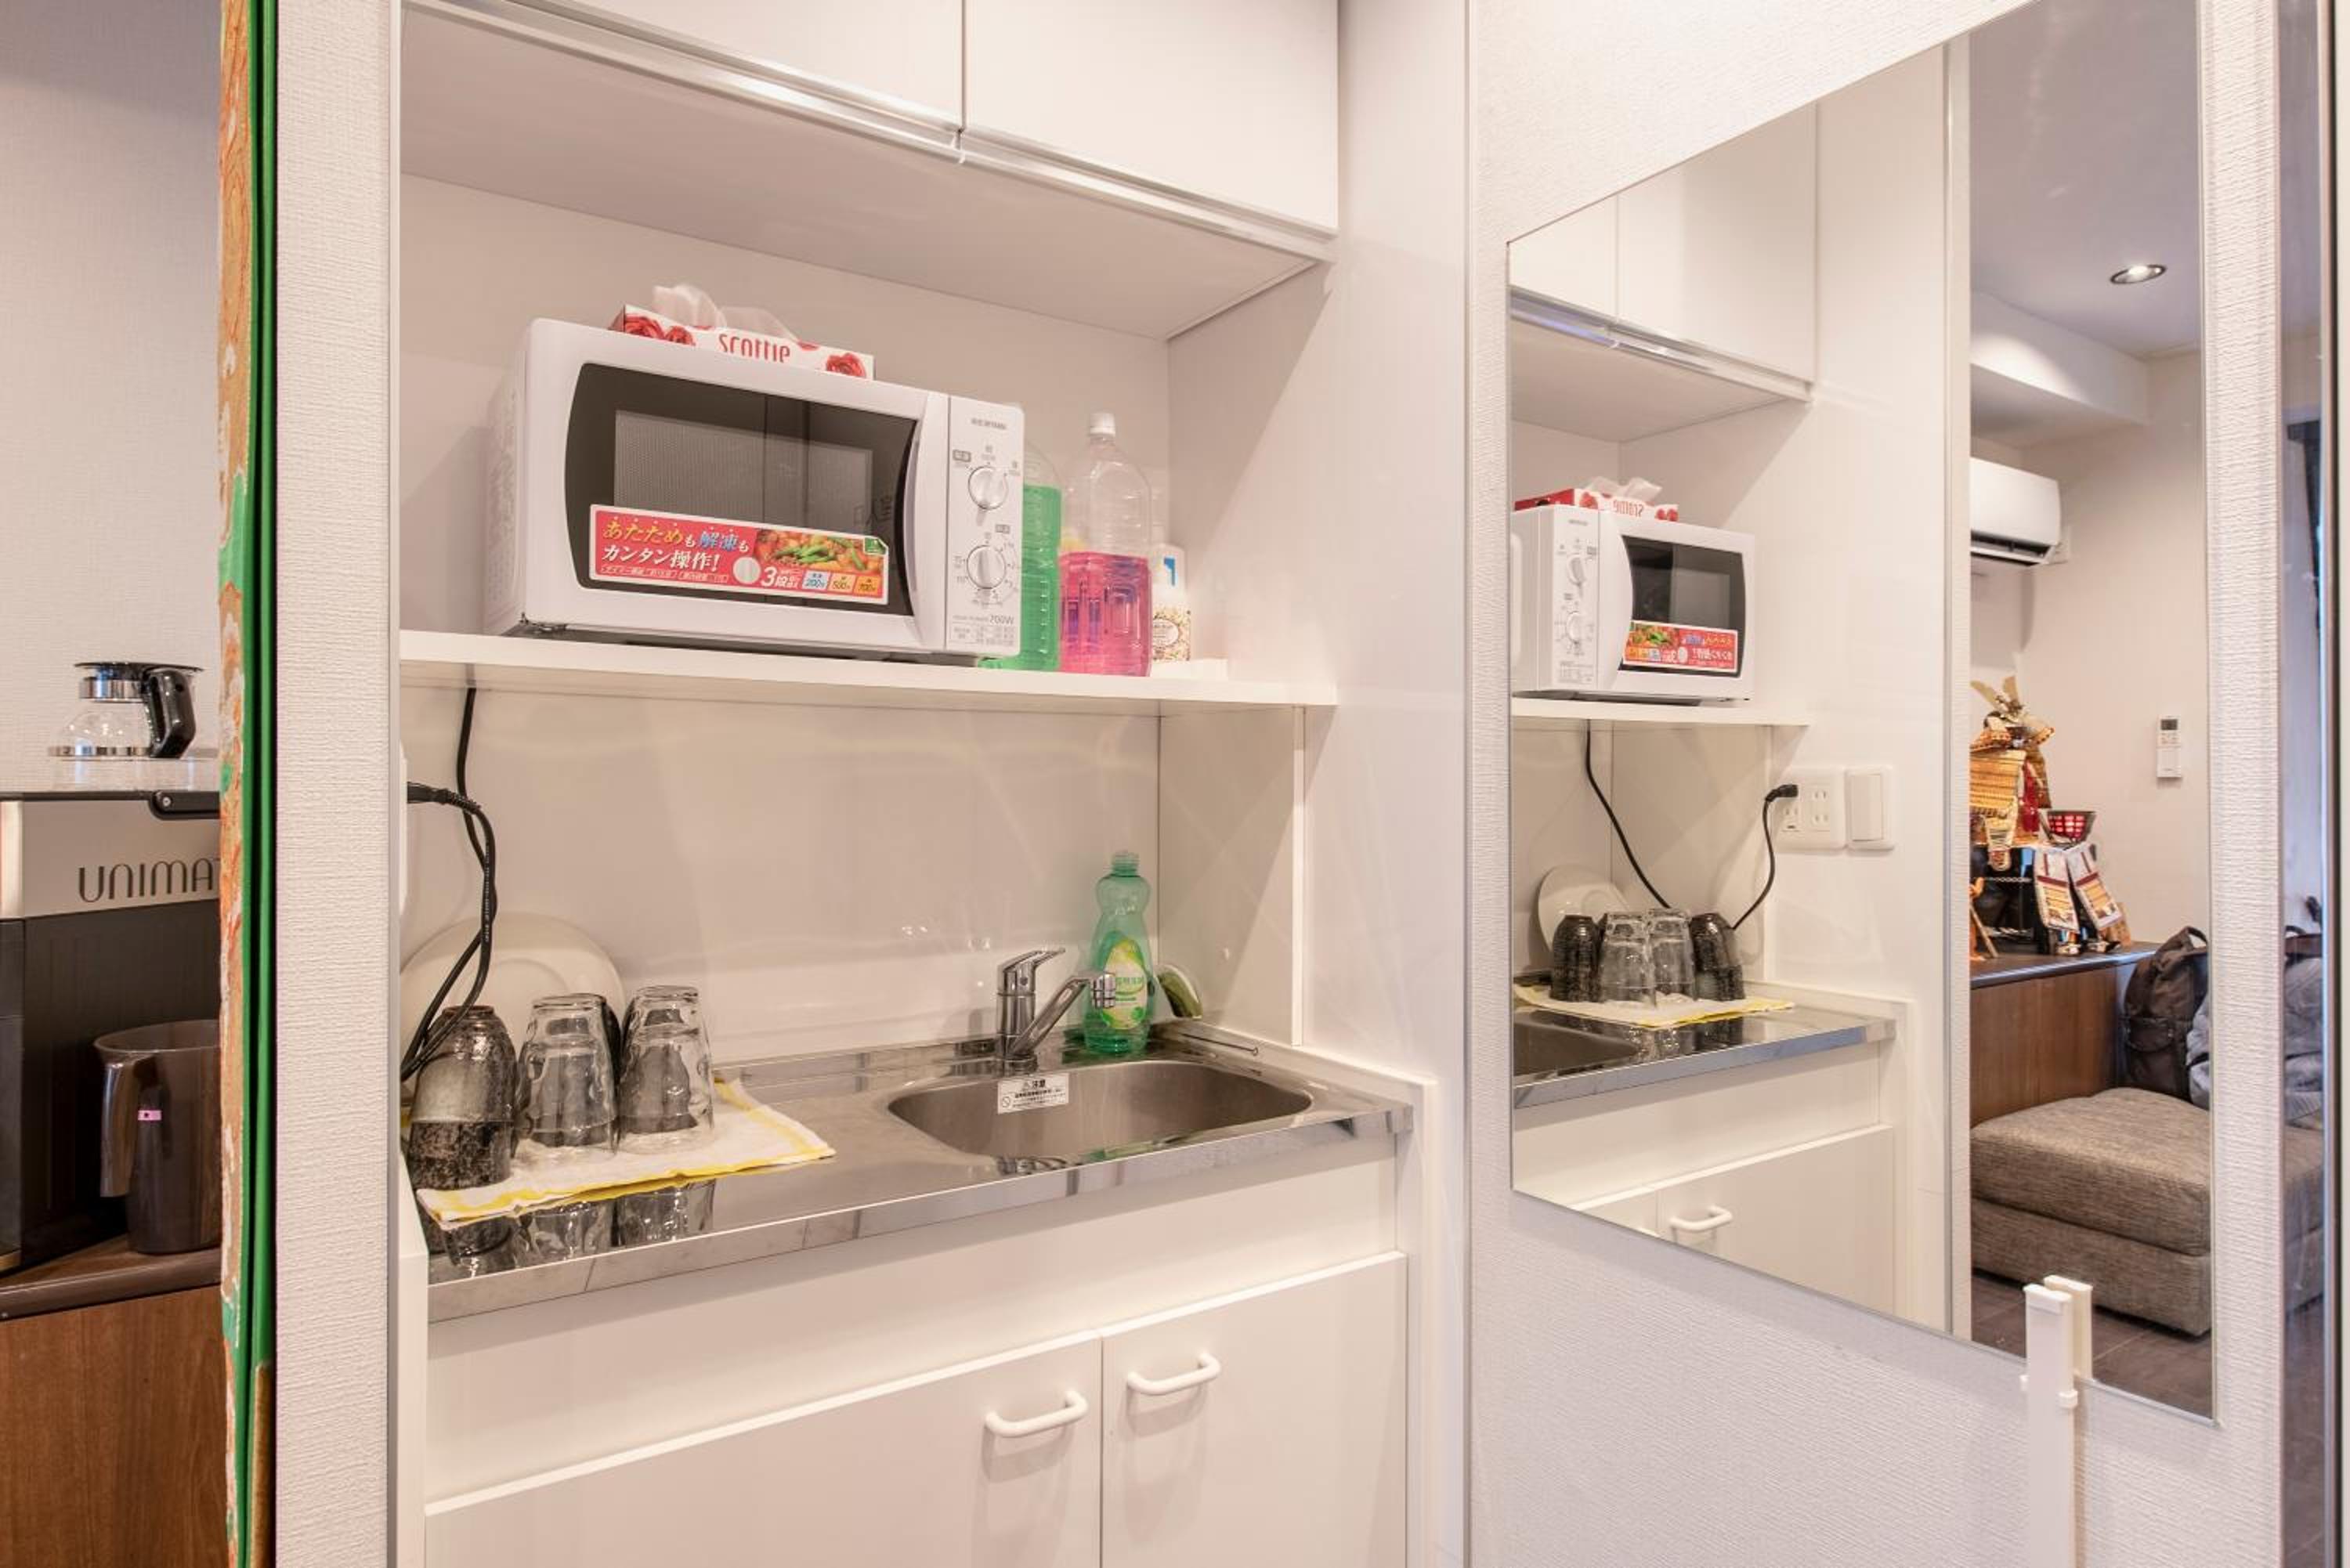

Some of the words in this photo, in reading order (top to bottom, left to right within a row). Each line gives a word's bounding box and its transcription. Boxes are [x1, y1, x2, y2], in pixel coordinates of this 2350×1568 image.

[602, 544, 721, 573] カンタン操作!
[78, 858, 220, 903] UNIMA
